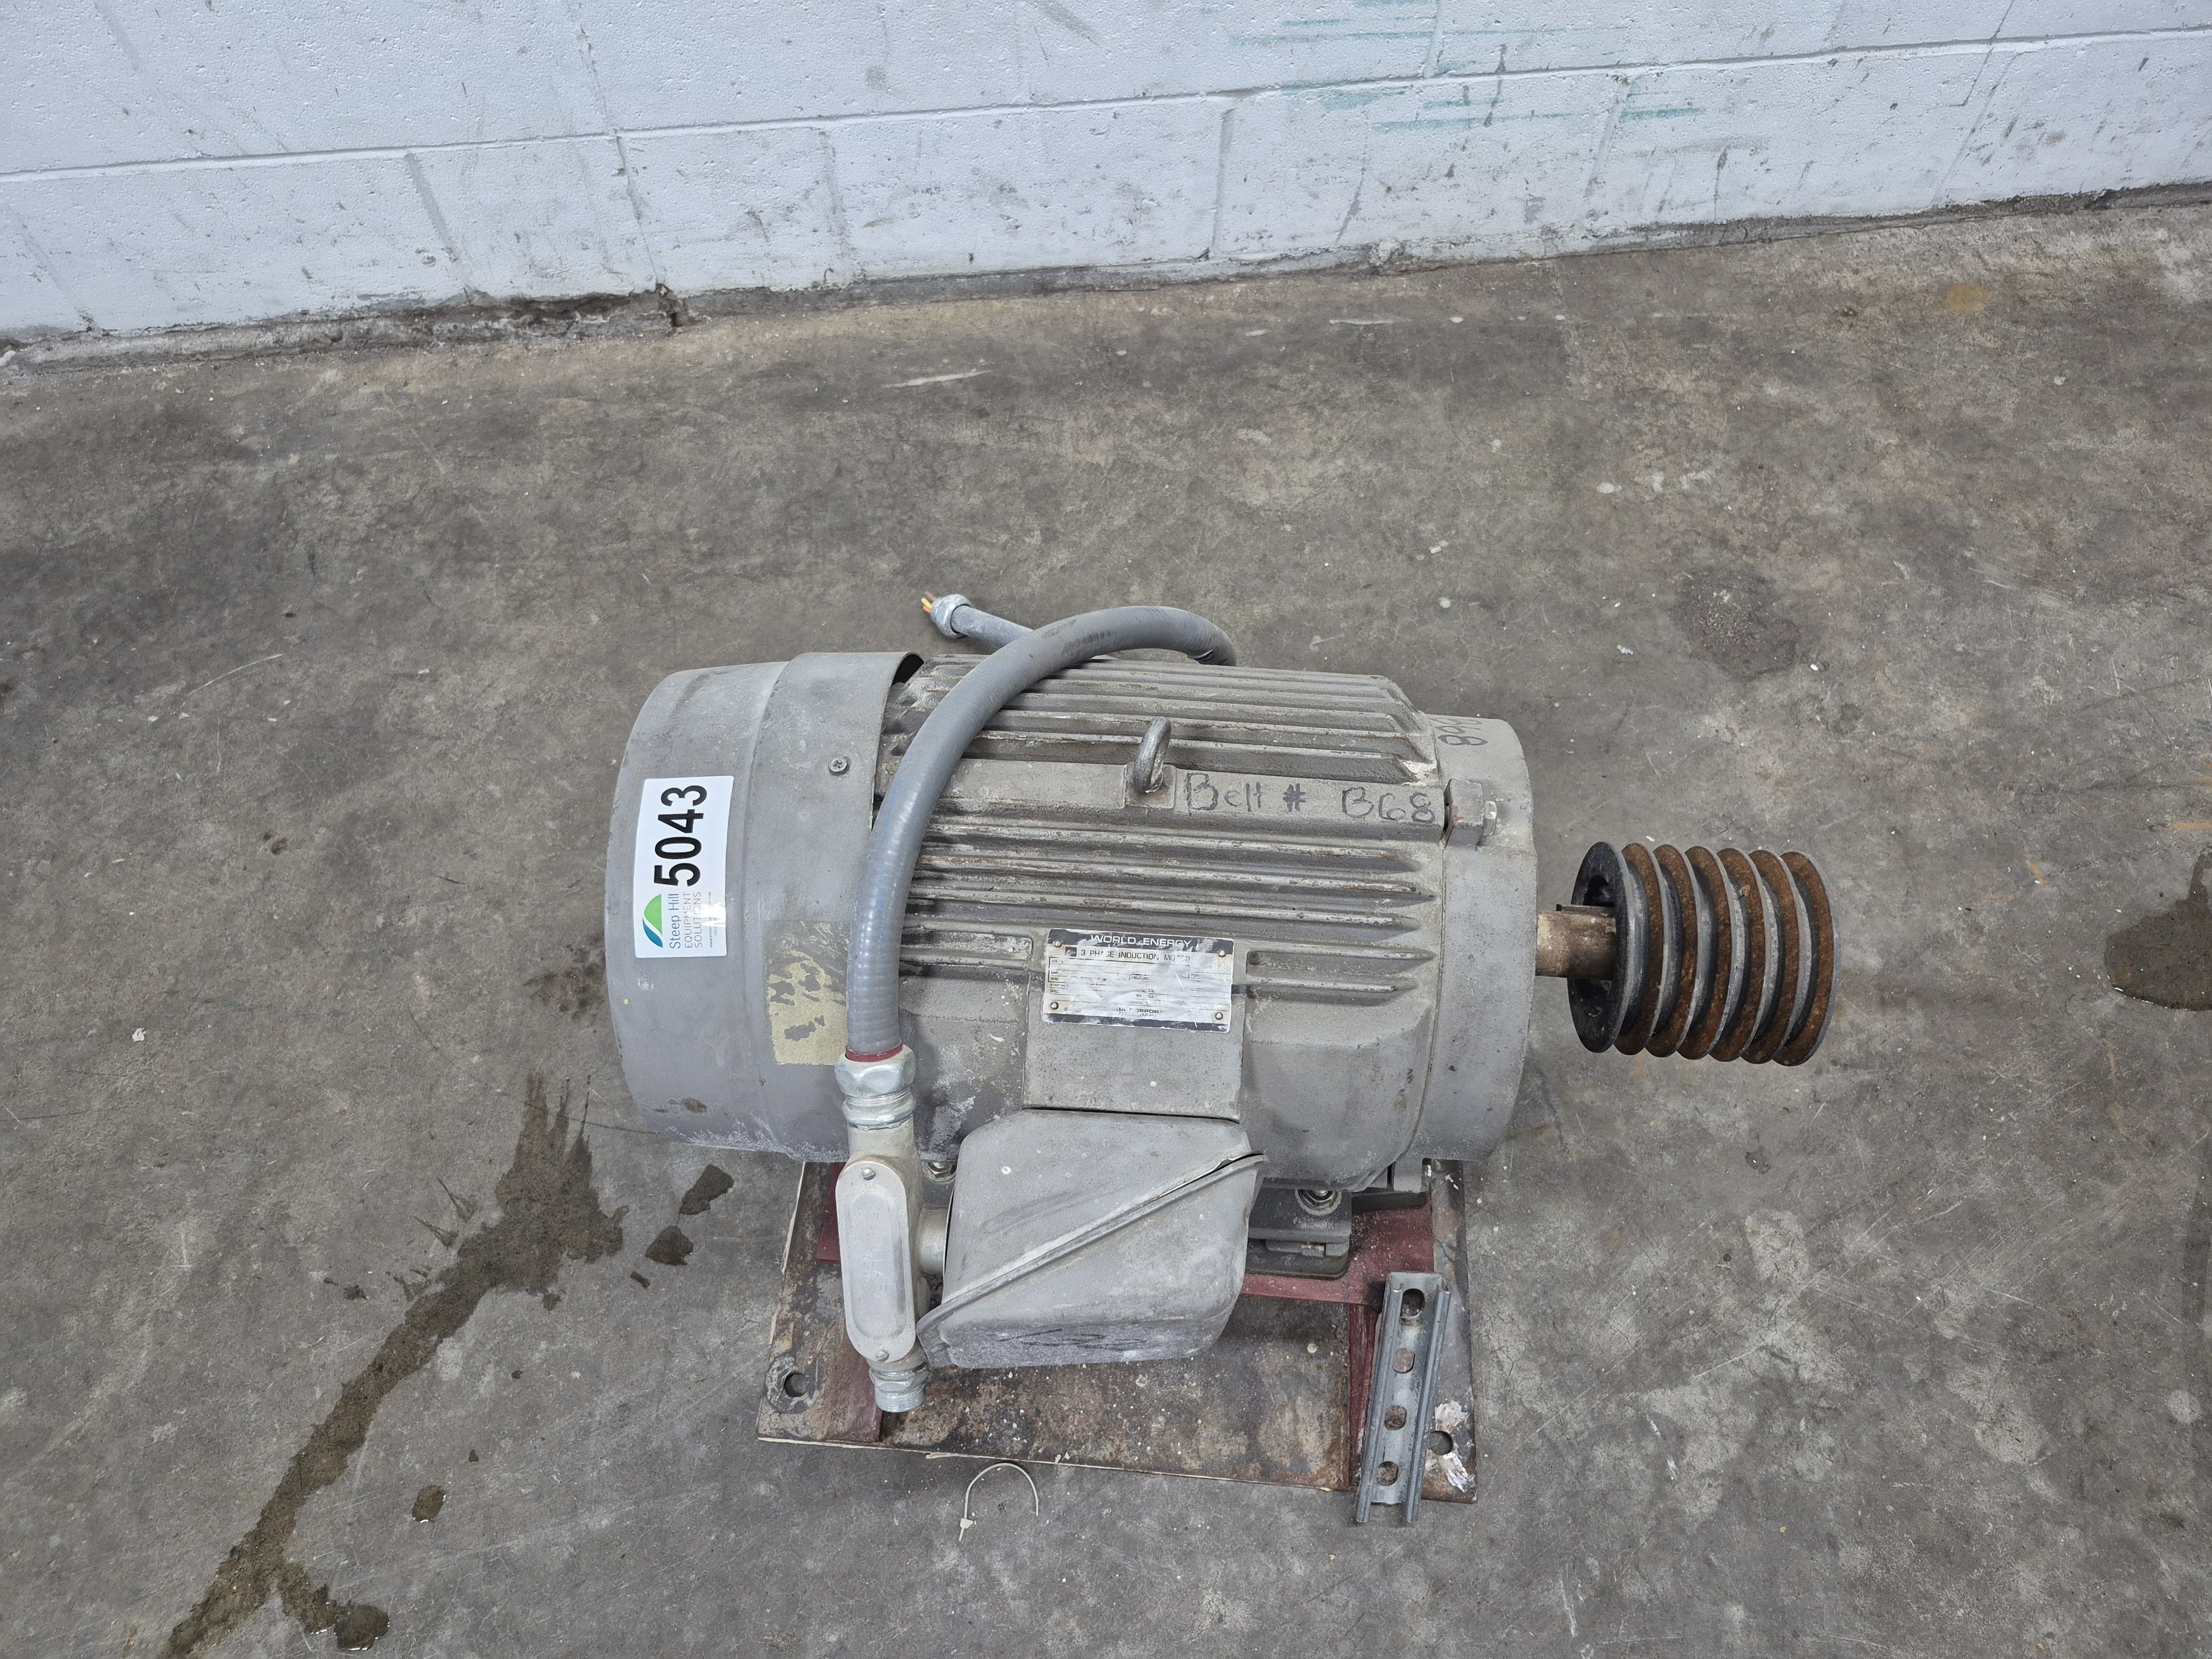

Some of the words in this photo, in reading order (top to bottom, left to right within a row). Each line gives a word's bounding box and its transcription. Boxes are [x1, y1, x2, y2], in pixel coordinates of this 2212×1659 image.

[1185, 772, 1263, 813] Belt
[1282, 783, 1306, 813] #
[654, 785, 707, 887] 5043
[668, 894, 680, 911] Hill
[683, 892, 693, 948] EQUIPMENT
[692, 891, 703, 948] SOLUTIONS
[669, 915, 682, 949] Steep
[1091, 934, 1136, 945] WORLD
[1142, 937, 1192, 947] ENERGY
[1118, 951, 1160, 961] INDUCTION
